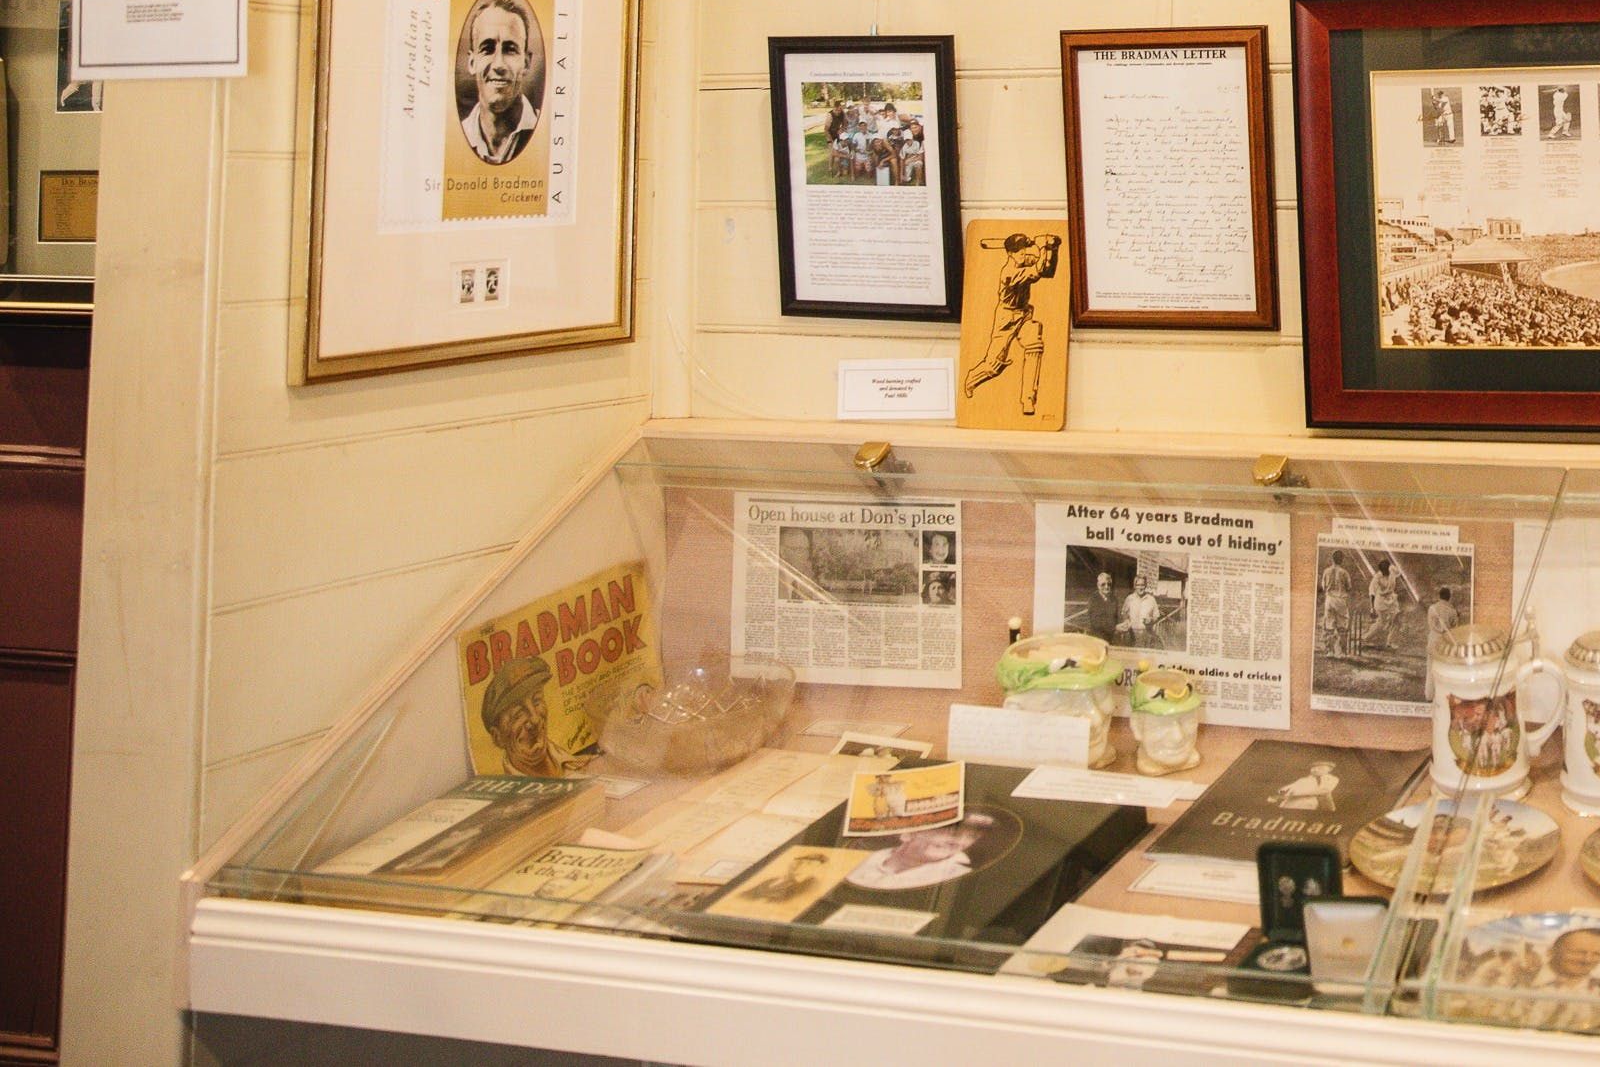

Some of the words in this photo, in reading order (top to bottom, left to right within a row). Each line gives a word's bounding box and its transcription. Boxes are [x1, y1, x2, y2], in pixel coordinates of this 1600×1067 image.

[419, 9, 436, 88] Legends
[1093, 50, 1118, 61] THE
[1121, 49, 1178, 61] BRADMAN
[1183, 49, 1227, 60] LETTER
[402, 9, 419, 120] Australian
[424, 177, 442, 192] Sir
[446, 176, 488, 191] Donald
[492, 176, 544, 190] Bradman
[499, 191, 543, 204] Cricketer
[748, 504, 786, 524] Open
[790, 508, 836, 524] house
[839, 510, 856, 524] at
[860, 508, 907, 525] Don's
[911, 509, 955, 528] place
[1066, 504, 1105, 520] After
[1109, 506, 1130, 521] 64
[1135, 510, 1179, 525] years
[1183, 511, 1254, 530] Bradman
[1085, 526, 1115, 542] ball
[1120, 528, 1173, 545] 'comes
[1177, 533, 1202, 547] out
[1207, 533, 1223, 548] of
[1228, 535, 1283, 556] hiding'
[1318, 536, 1350, 545] BRADMAN
[1435, 544, 1453, 552] LAST
[466, 573, 636, 687] BRADMAN
[554, 613, 647, 688] BOOK
[1198, 666, 1230, 679] oldies
[1232, 668, 1244, 679] of
[1247, 669, 1282, 683] cricket
[461, 779, 515, 795] THE
[516, 780, 576, 796] DON
[1211, 811, 1345, 835] Bradman
